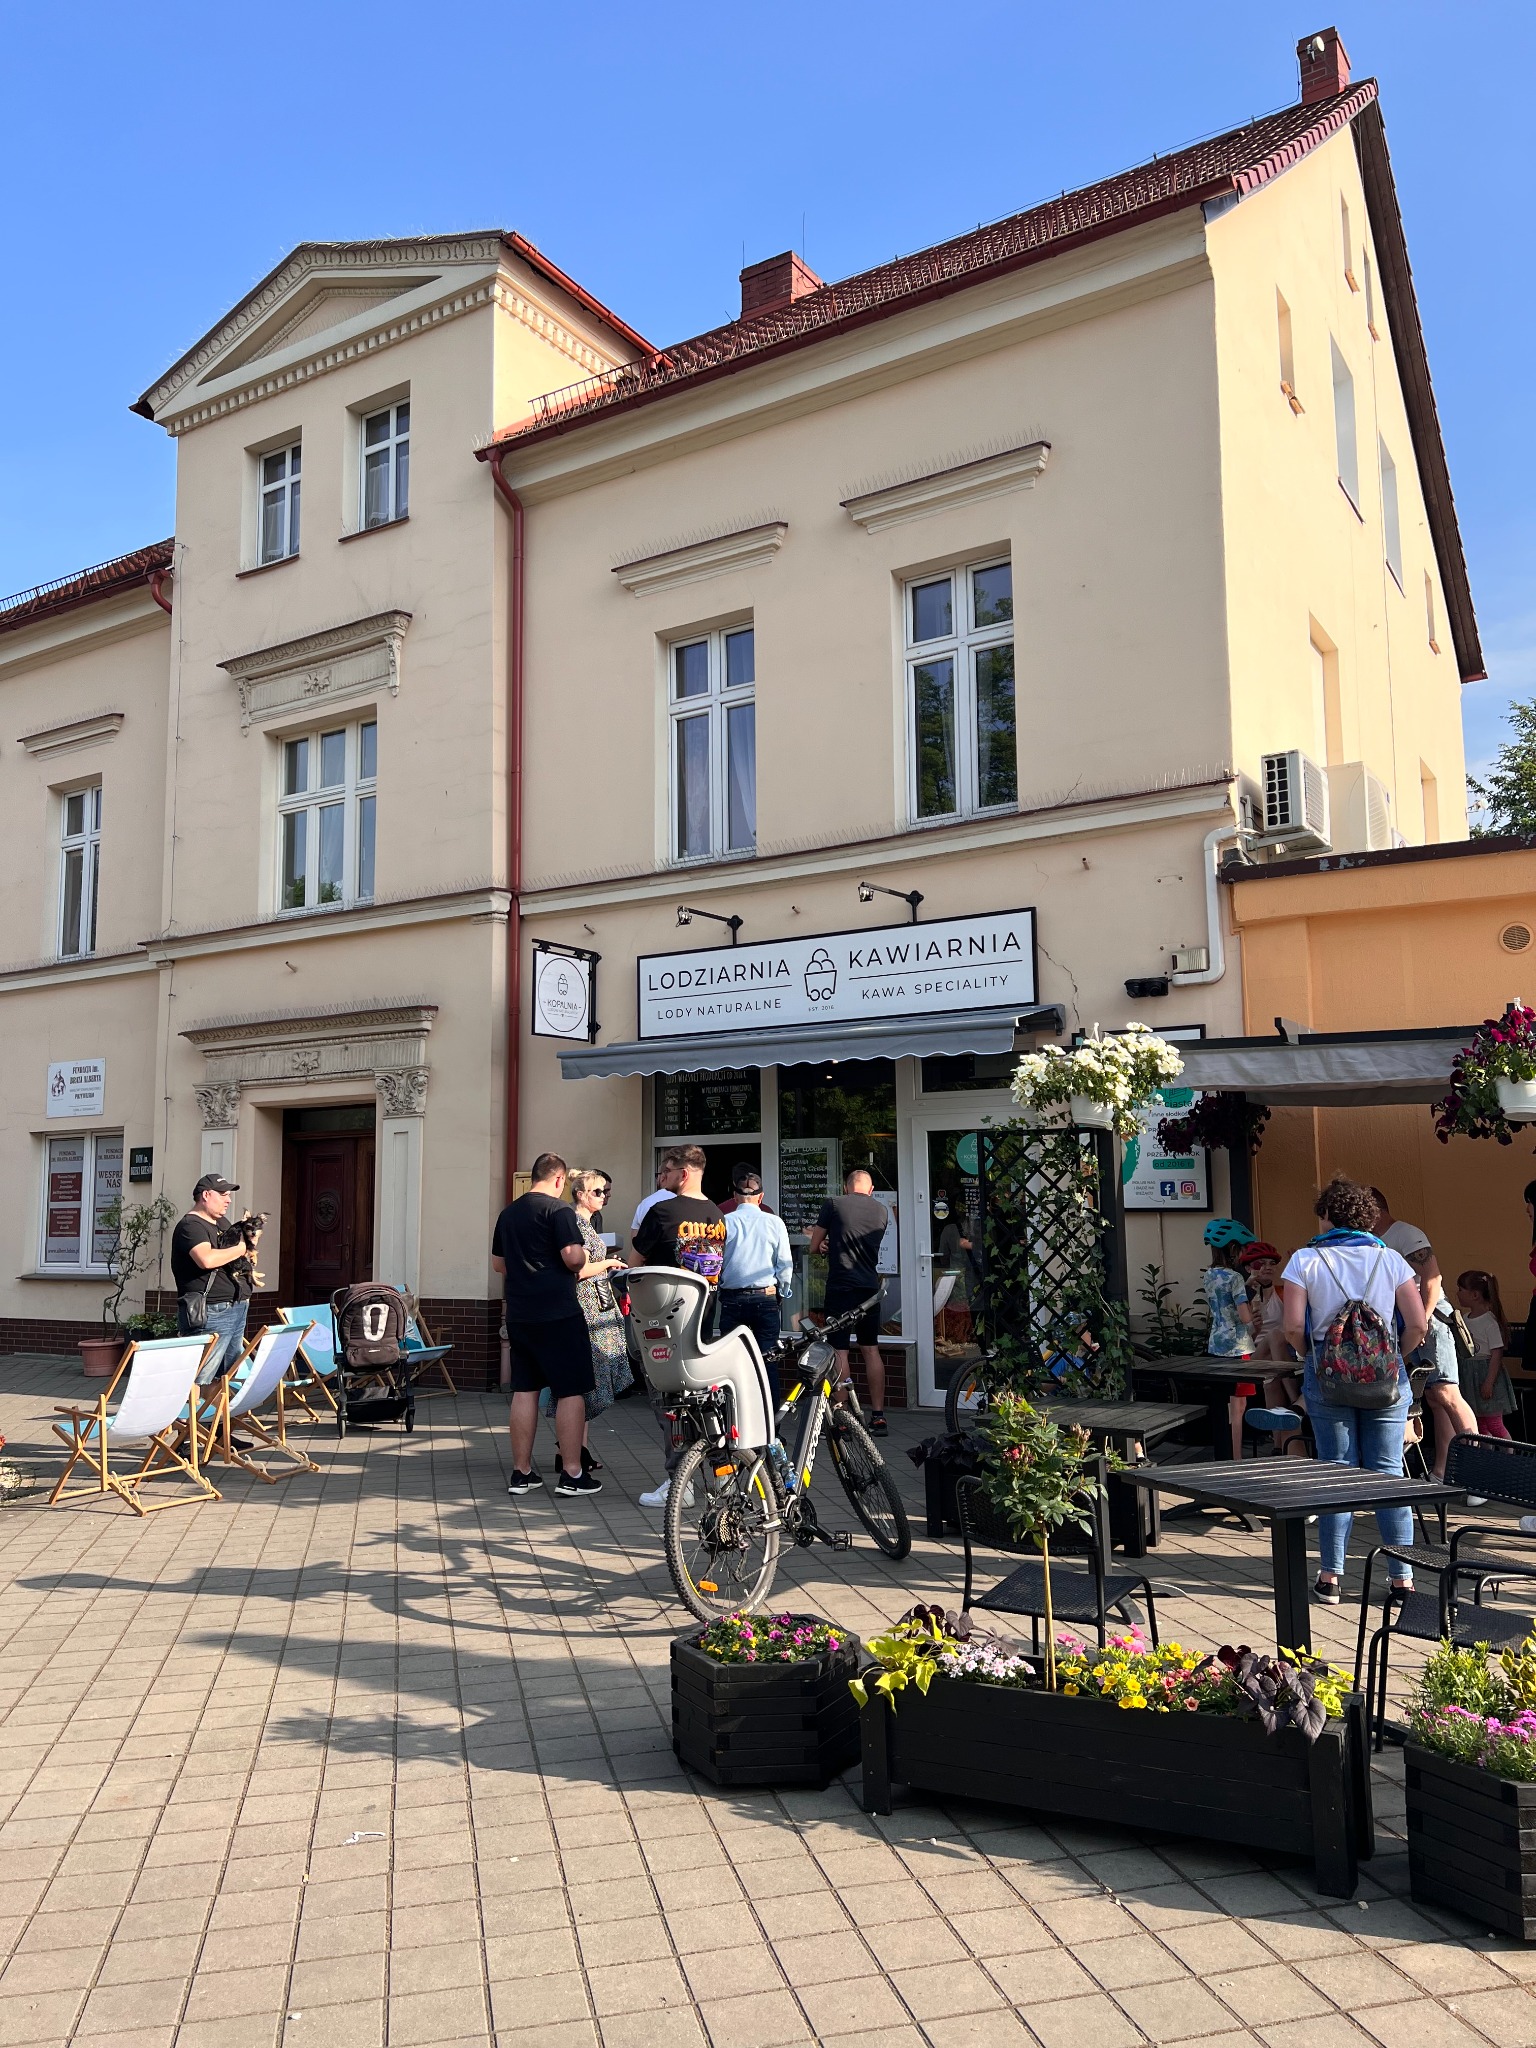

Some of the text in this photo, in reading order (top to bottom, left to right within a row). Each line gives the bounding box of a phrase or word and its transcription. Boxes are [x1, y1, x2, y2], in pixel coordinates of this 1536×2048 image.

[849, 931, 1021, 969] KAWIARNIA
[649, 959, 790, 991] LODZIARNIA
[862, 975, 1009, 1000] KAWA SPECIALITY
[547, 1000, 578, 1010] KOPALNIA
[658, 998, 782, 1020] LODY NATURALNE
[1164, 1100, 1193, 1108] ciasta
